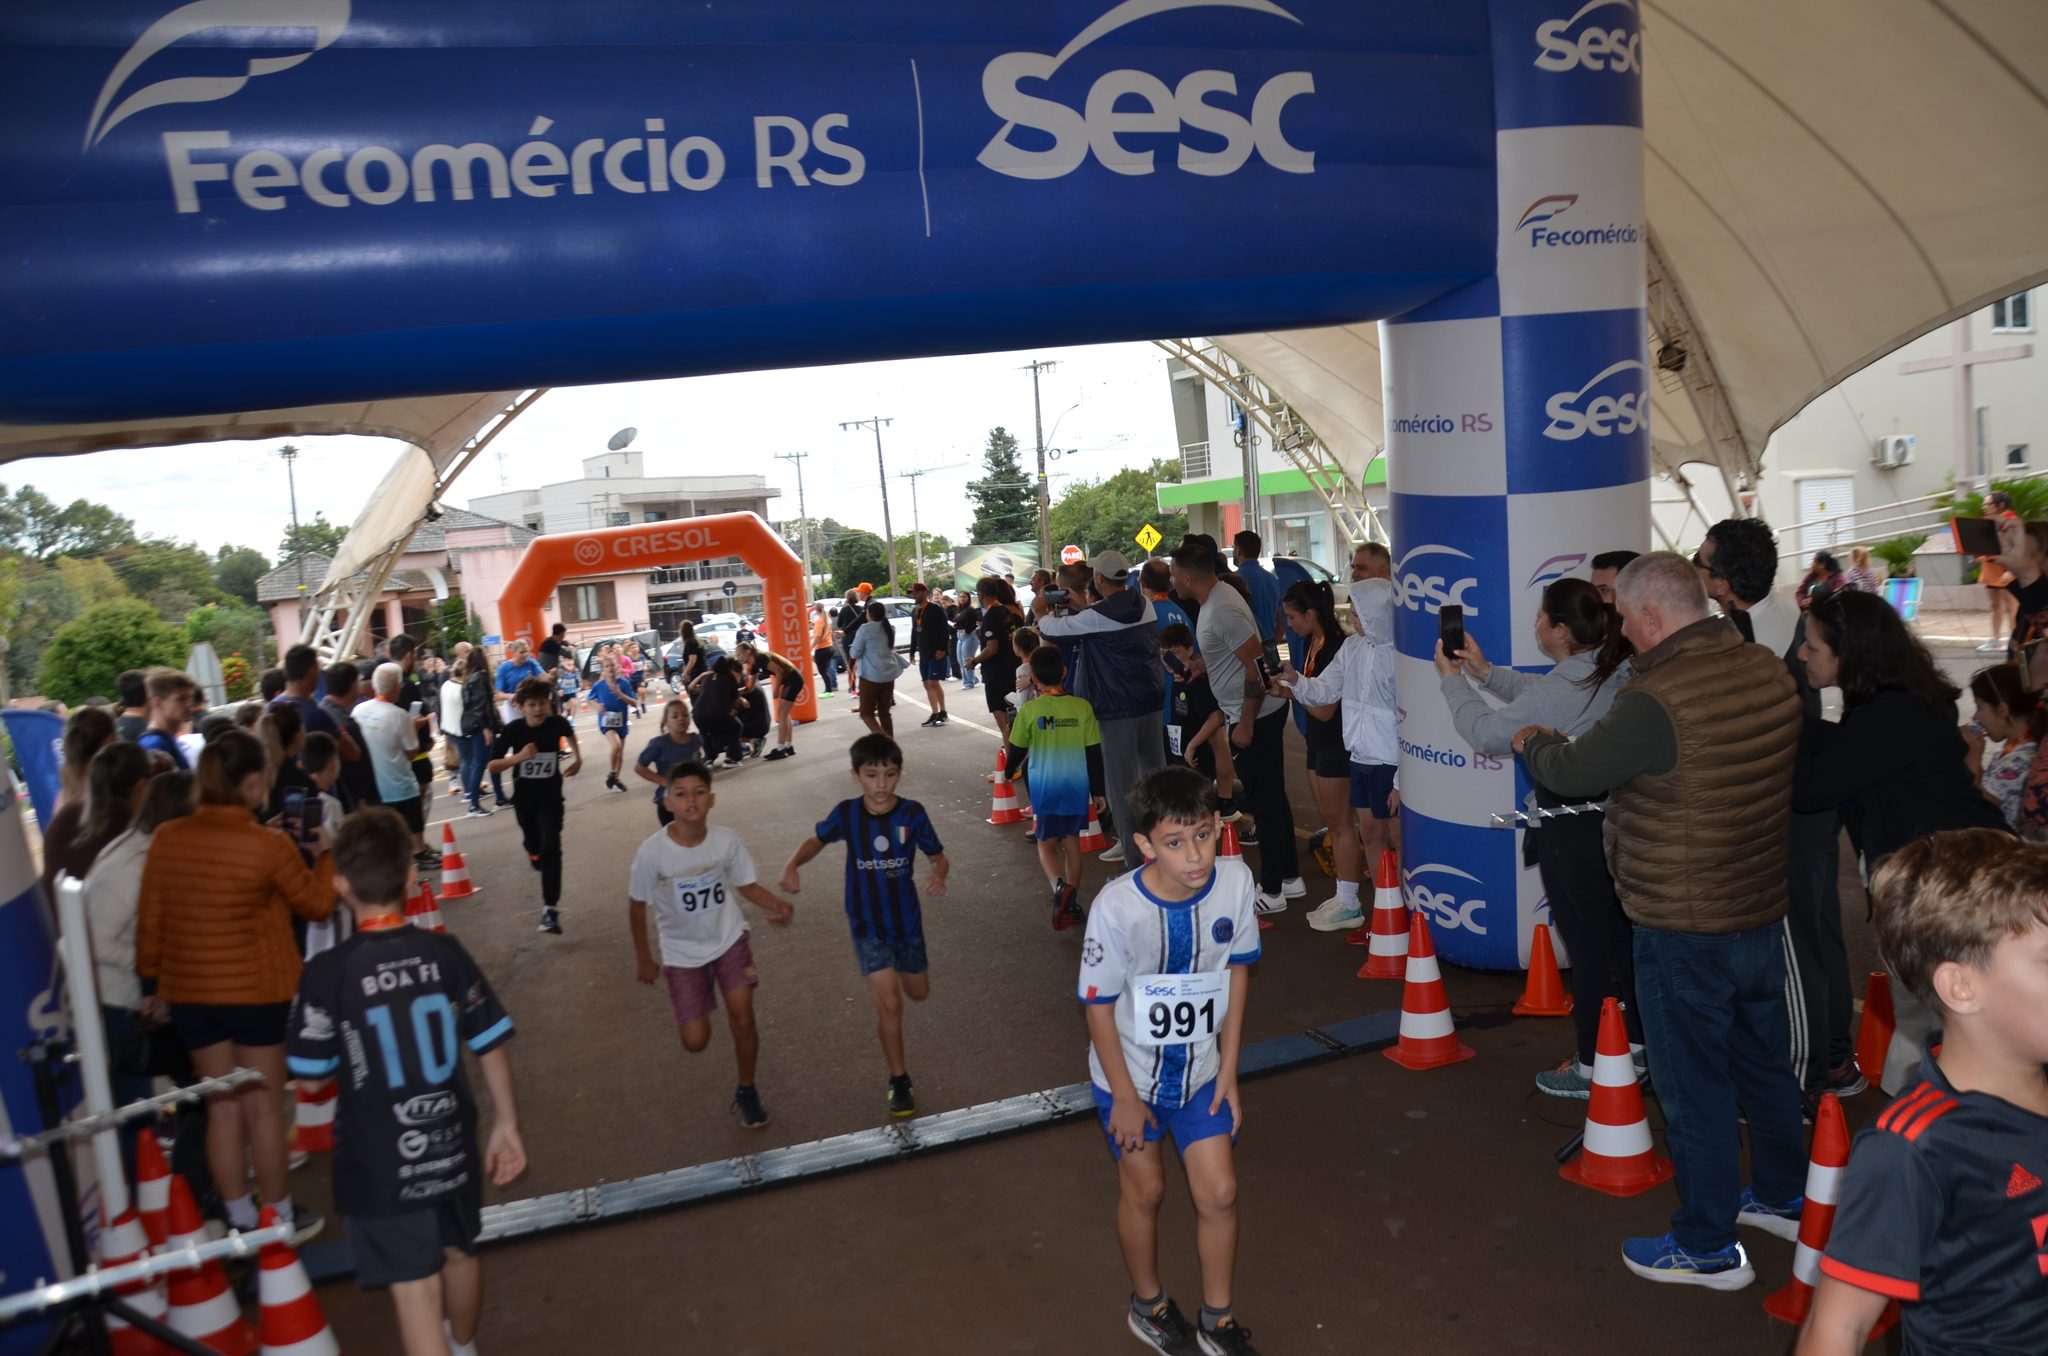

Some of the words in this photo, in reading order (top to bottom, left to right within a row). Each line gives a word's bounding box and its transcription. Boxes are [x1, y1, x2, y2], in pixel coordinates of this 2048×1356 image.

[976, 48, 1316, 181] Sesc
[162, 115, 726, 213] Fecomércio
[753, 113, 866, 189] RS
[1531, 222, 1638, 248] Fecomércio
[1391, 413, 1455, 434] omércio
[1460, 412, 1493, 433] RS
[612, 526, 720, 559] CRESOL
[525, 761, 553, 777] 974
[1472, 752, 1504, 771] RS
[856, 857, 909, 870] betsson
[682, 881, 726, 912] 976
[361, 968, 414, 997] BOA
[1144, 984, 1177, 997] Sesc
[1148, 998, 1215, 1039] 991
[365, 992, 459, 1089] 10
[2006, 1176, 2043, 1199] adidas
